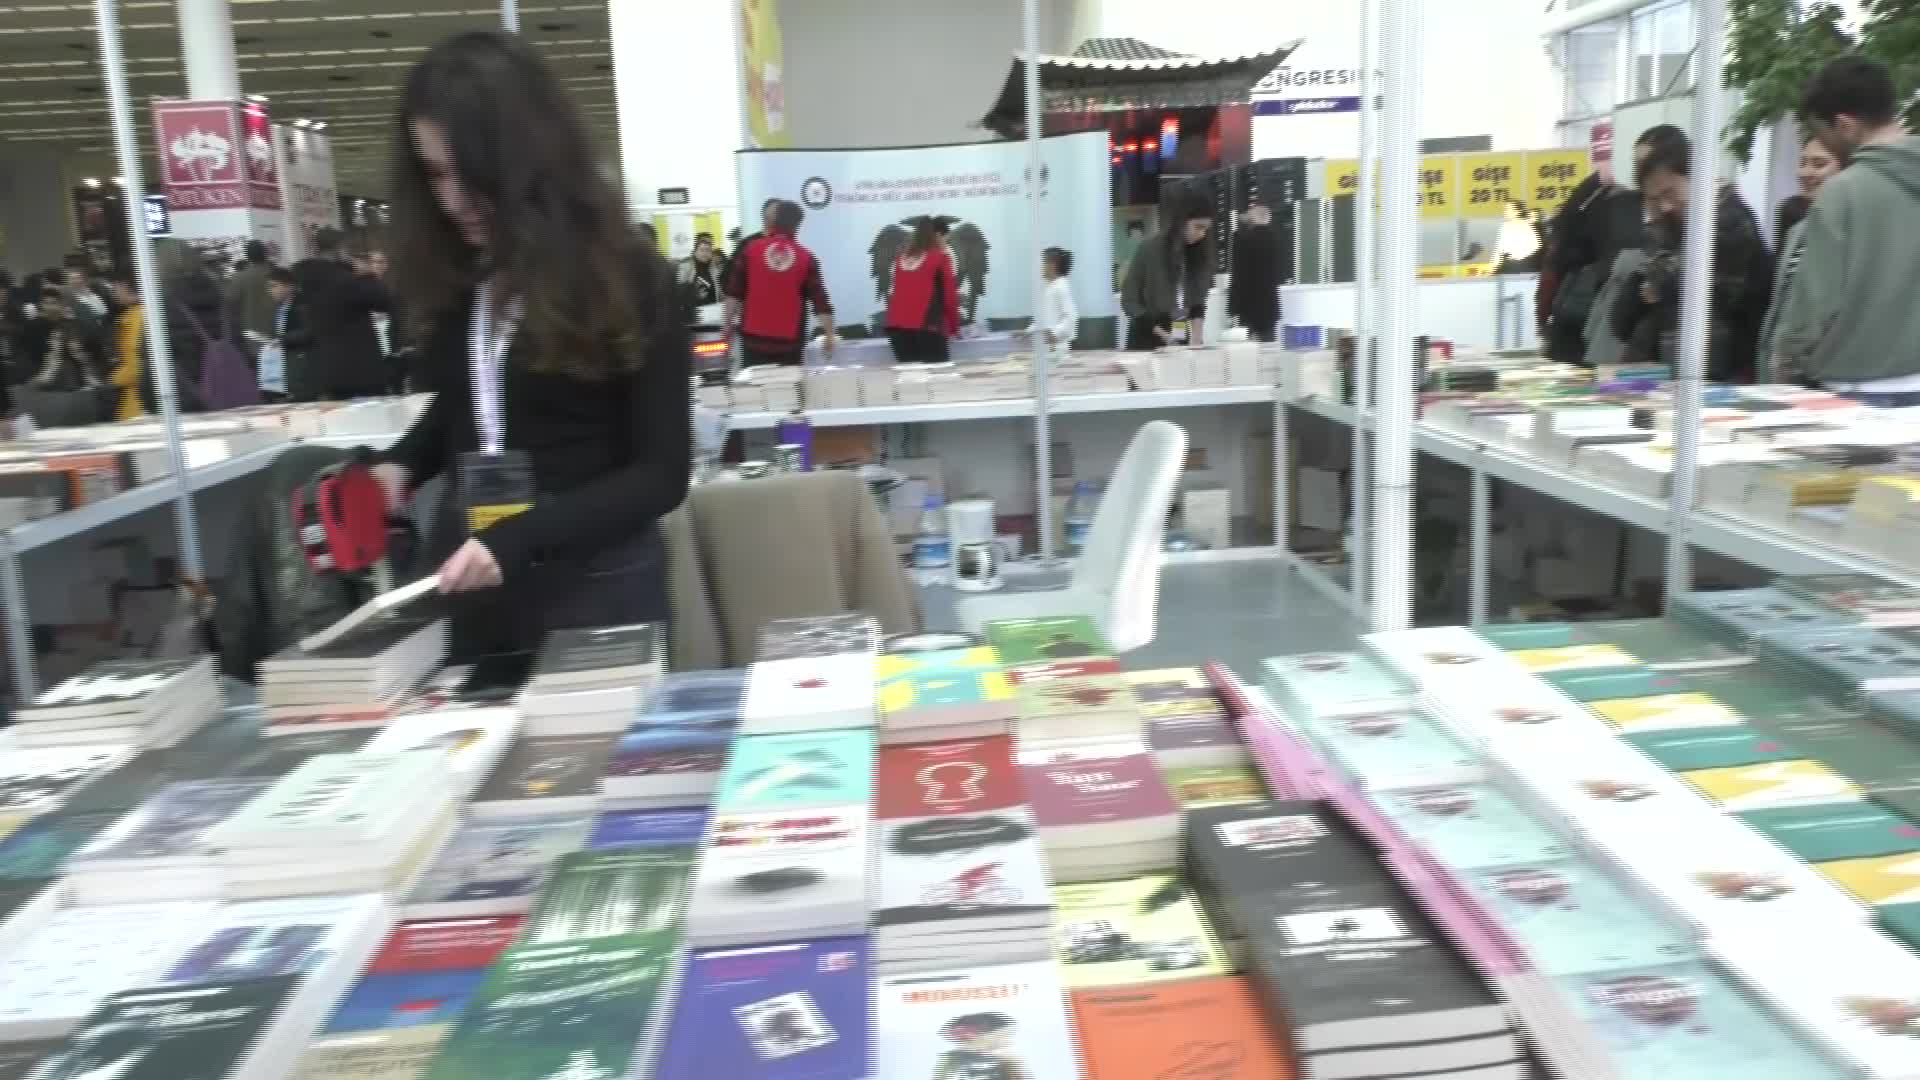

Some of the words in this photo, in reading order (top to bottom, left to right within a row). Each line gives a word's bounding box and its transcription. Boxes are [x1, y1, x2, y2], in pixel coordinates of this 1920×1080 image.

[1336, 170, 1361, 189] Gİ
[1471, 164, 1512, 185] GİŞE
[1537, 161, 1578, 183] GİŞE
[168, 186, 245, 208] ÖTÜKEN
[1427, 191, 1447, 206] TL
[1468, 188, 1490, 204] 20
[1535, 185, 1556, 201] 20
